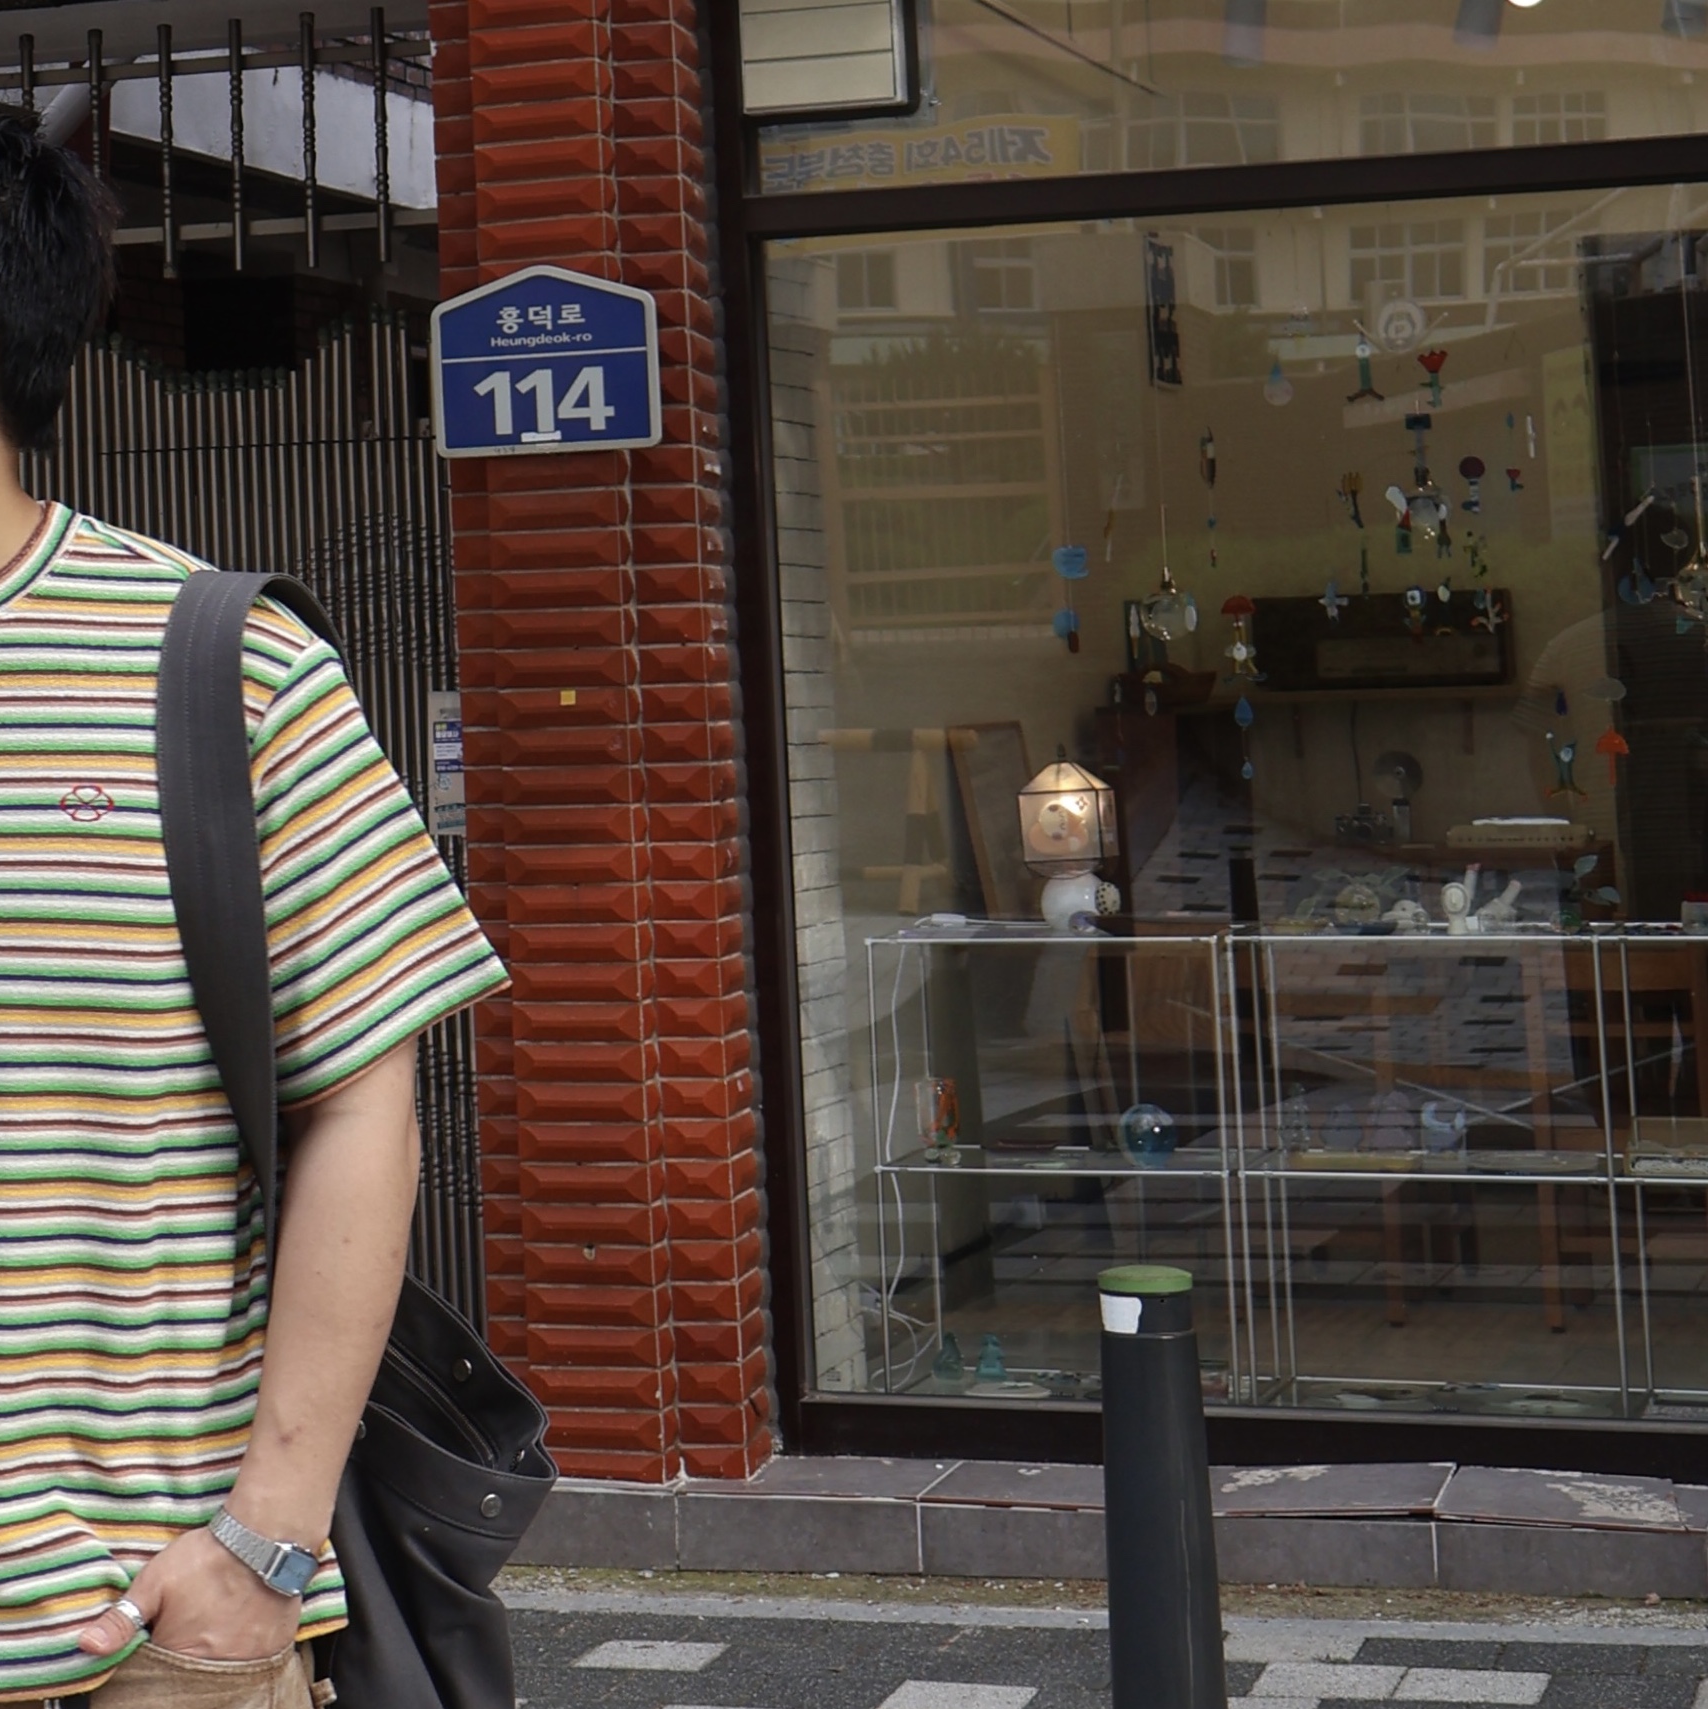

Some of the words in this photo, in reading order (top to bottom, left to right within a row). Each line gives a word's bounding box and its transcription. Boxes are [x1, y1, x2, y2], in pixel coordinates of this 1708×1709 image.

[495, 304, 586, 334] 흥덕로
[490, 331, 593, 348] Heungdeok-ro
[473, 366, 615, 436] 114
